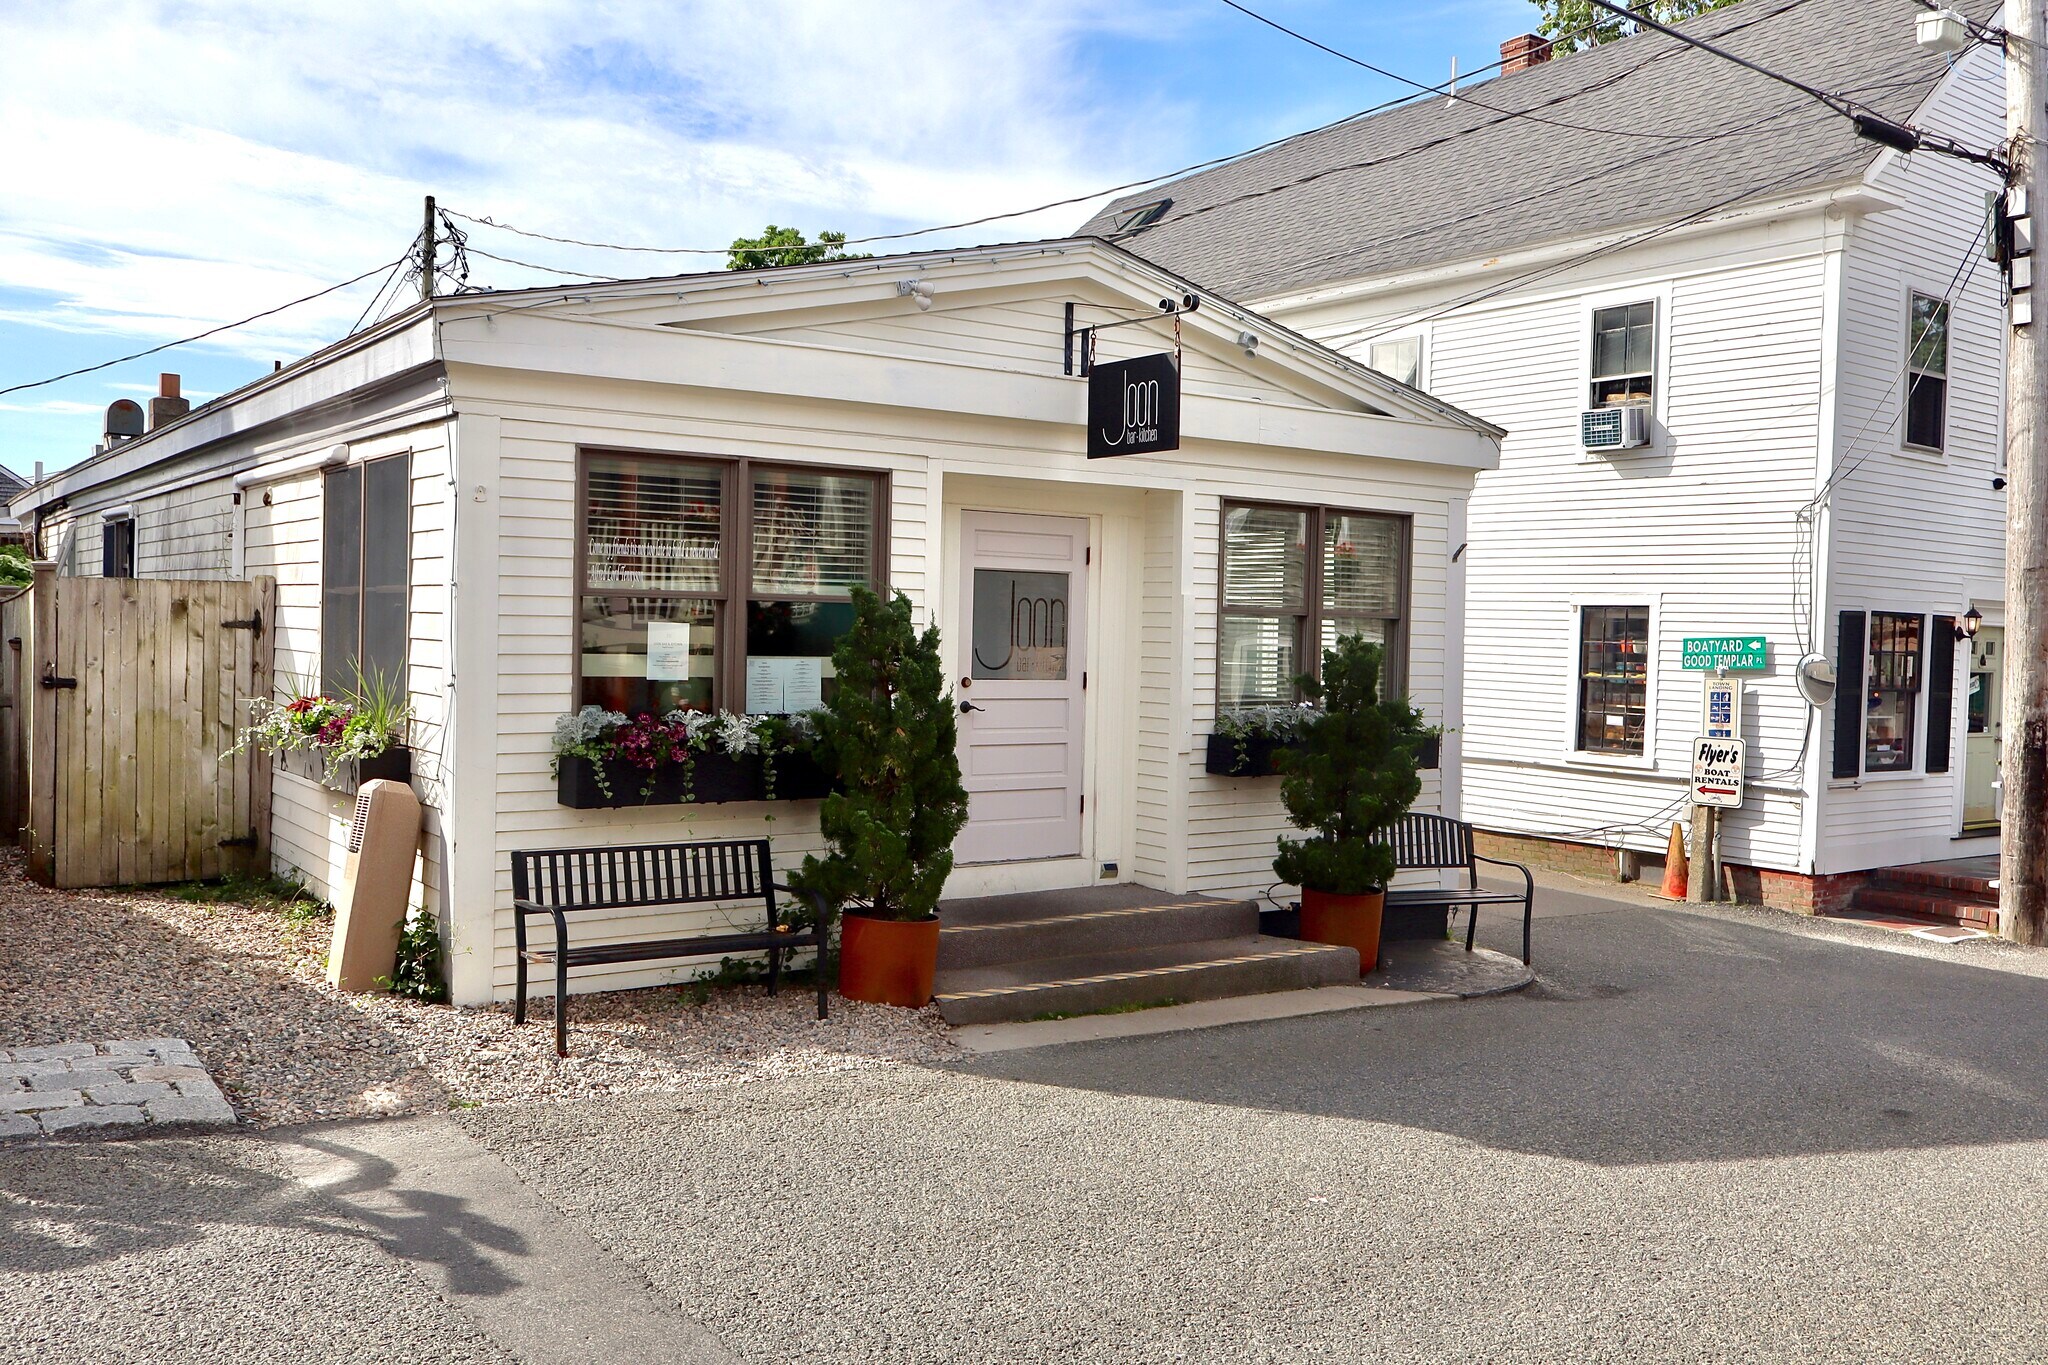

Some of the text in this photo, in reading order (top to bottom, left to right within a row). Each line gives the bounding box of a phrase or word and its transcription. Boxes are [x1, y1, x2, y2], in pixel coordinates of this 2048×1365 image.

[1102, 369, 1159, 446] Joon
[610, 536, 630, 560] friends
[974, 579, 1066, 671] Joon
[1687, 639, 1744, 653] BOATYARD
[1684, 653, 1763, 668] GOOD TEMPLAR PL
[1698, 743, 1739, 768] Flyer's
[1694, 776, 1740, 787] RENTALS
[1704, 768, 1731, 777] BOAT
